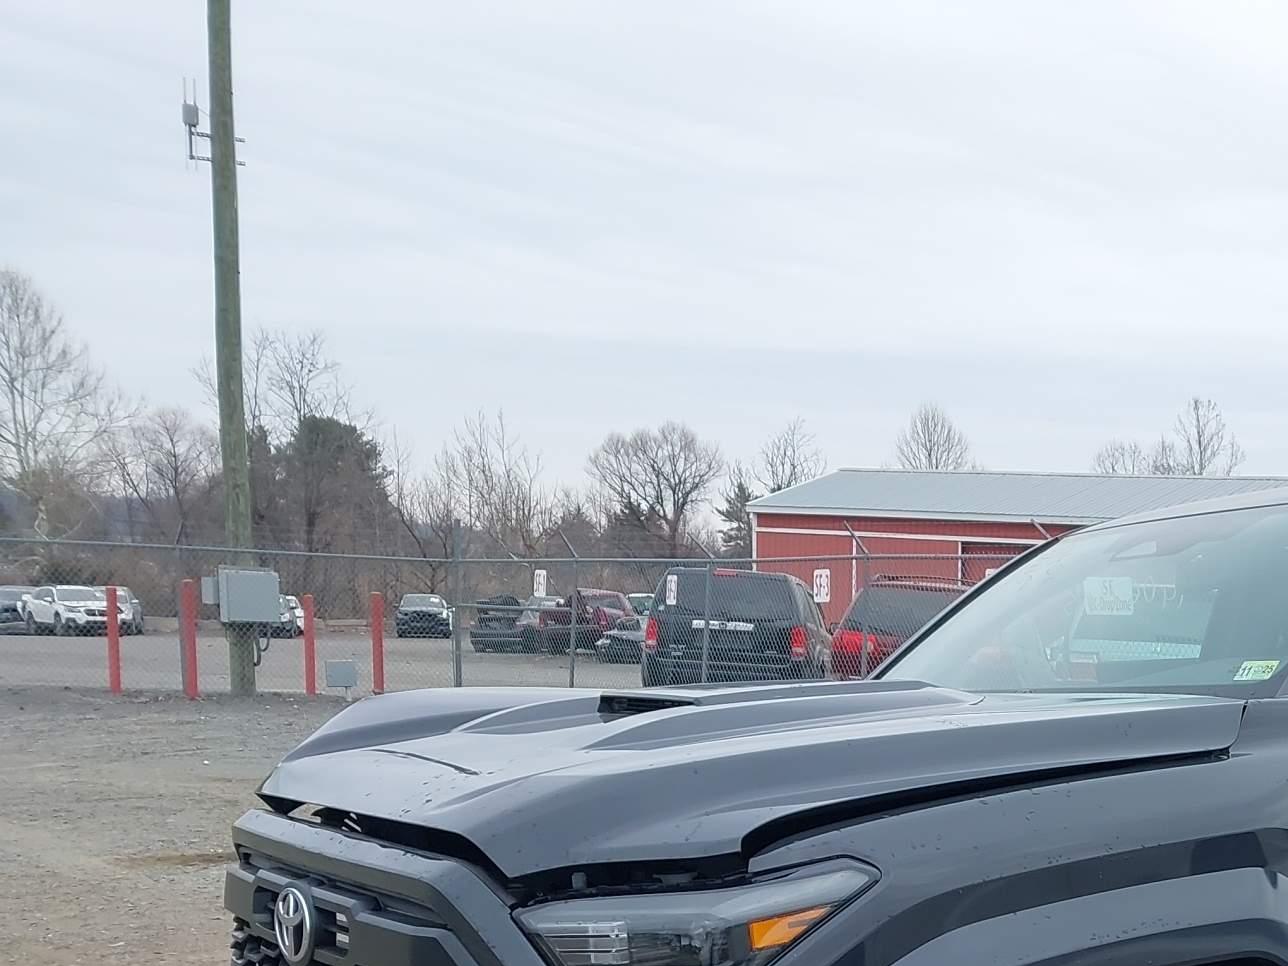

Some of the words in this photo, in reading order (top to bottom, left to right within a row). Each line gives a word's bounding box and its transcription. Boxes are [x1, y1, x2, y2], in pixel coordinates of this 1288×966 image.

[815, 574, 829, 597] SF-3
[1240, 665, 1253, 677] 11
[1262, 664, 1275, 674] 25
